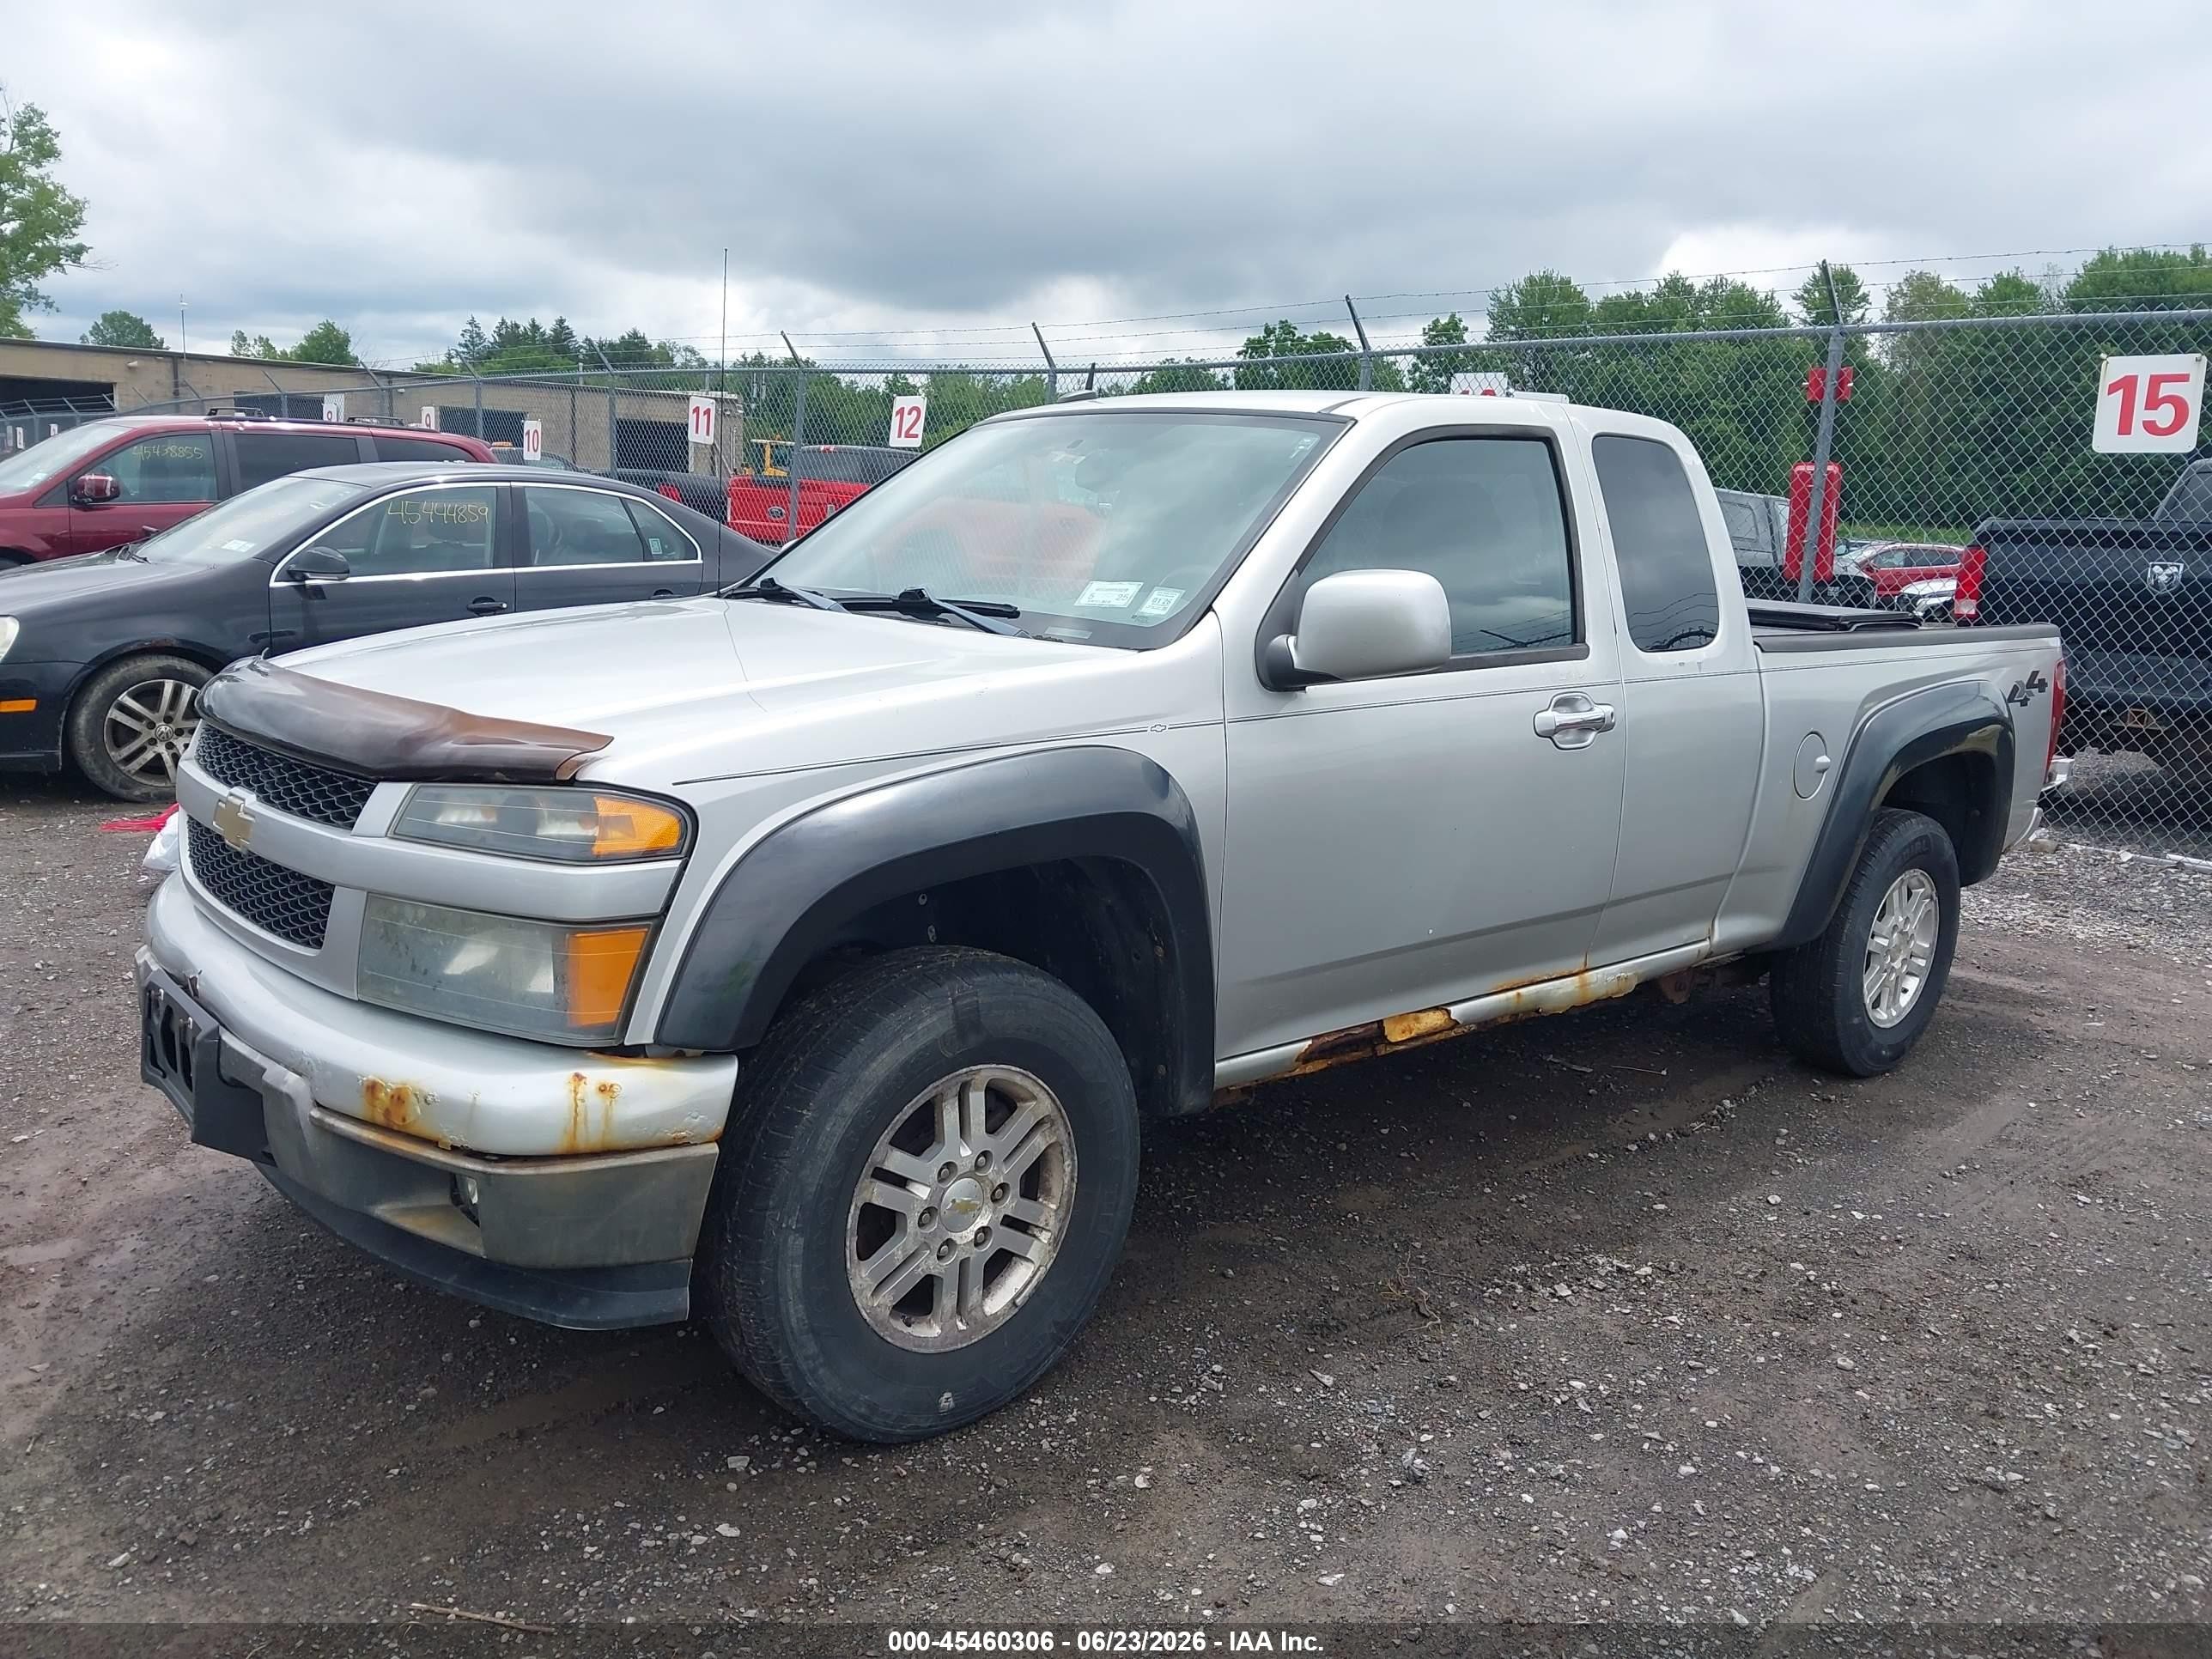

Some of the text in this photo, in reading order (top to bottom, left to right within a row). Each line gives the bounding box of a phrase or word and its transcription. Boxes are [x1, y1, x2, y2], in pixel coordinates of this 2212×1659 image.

[2107, 374, 2191, 436] 15
[692, 406, 711, 436] 11
[895, 406, 921, 438] 12
[525, 429, 539, 453] 10
[387, 501, 489, 525] 45444859
